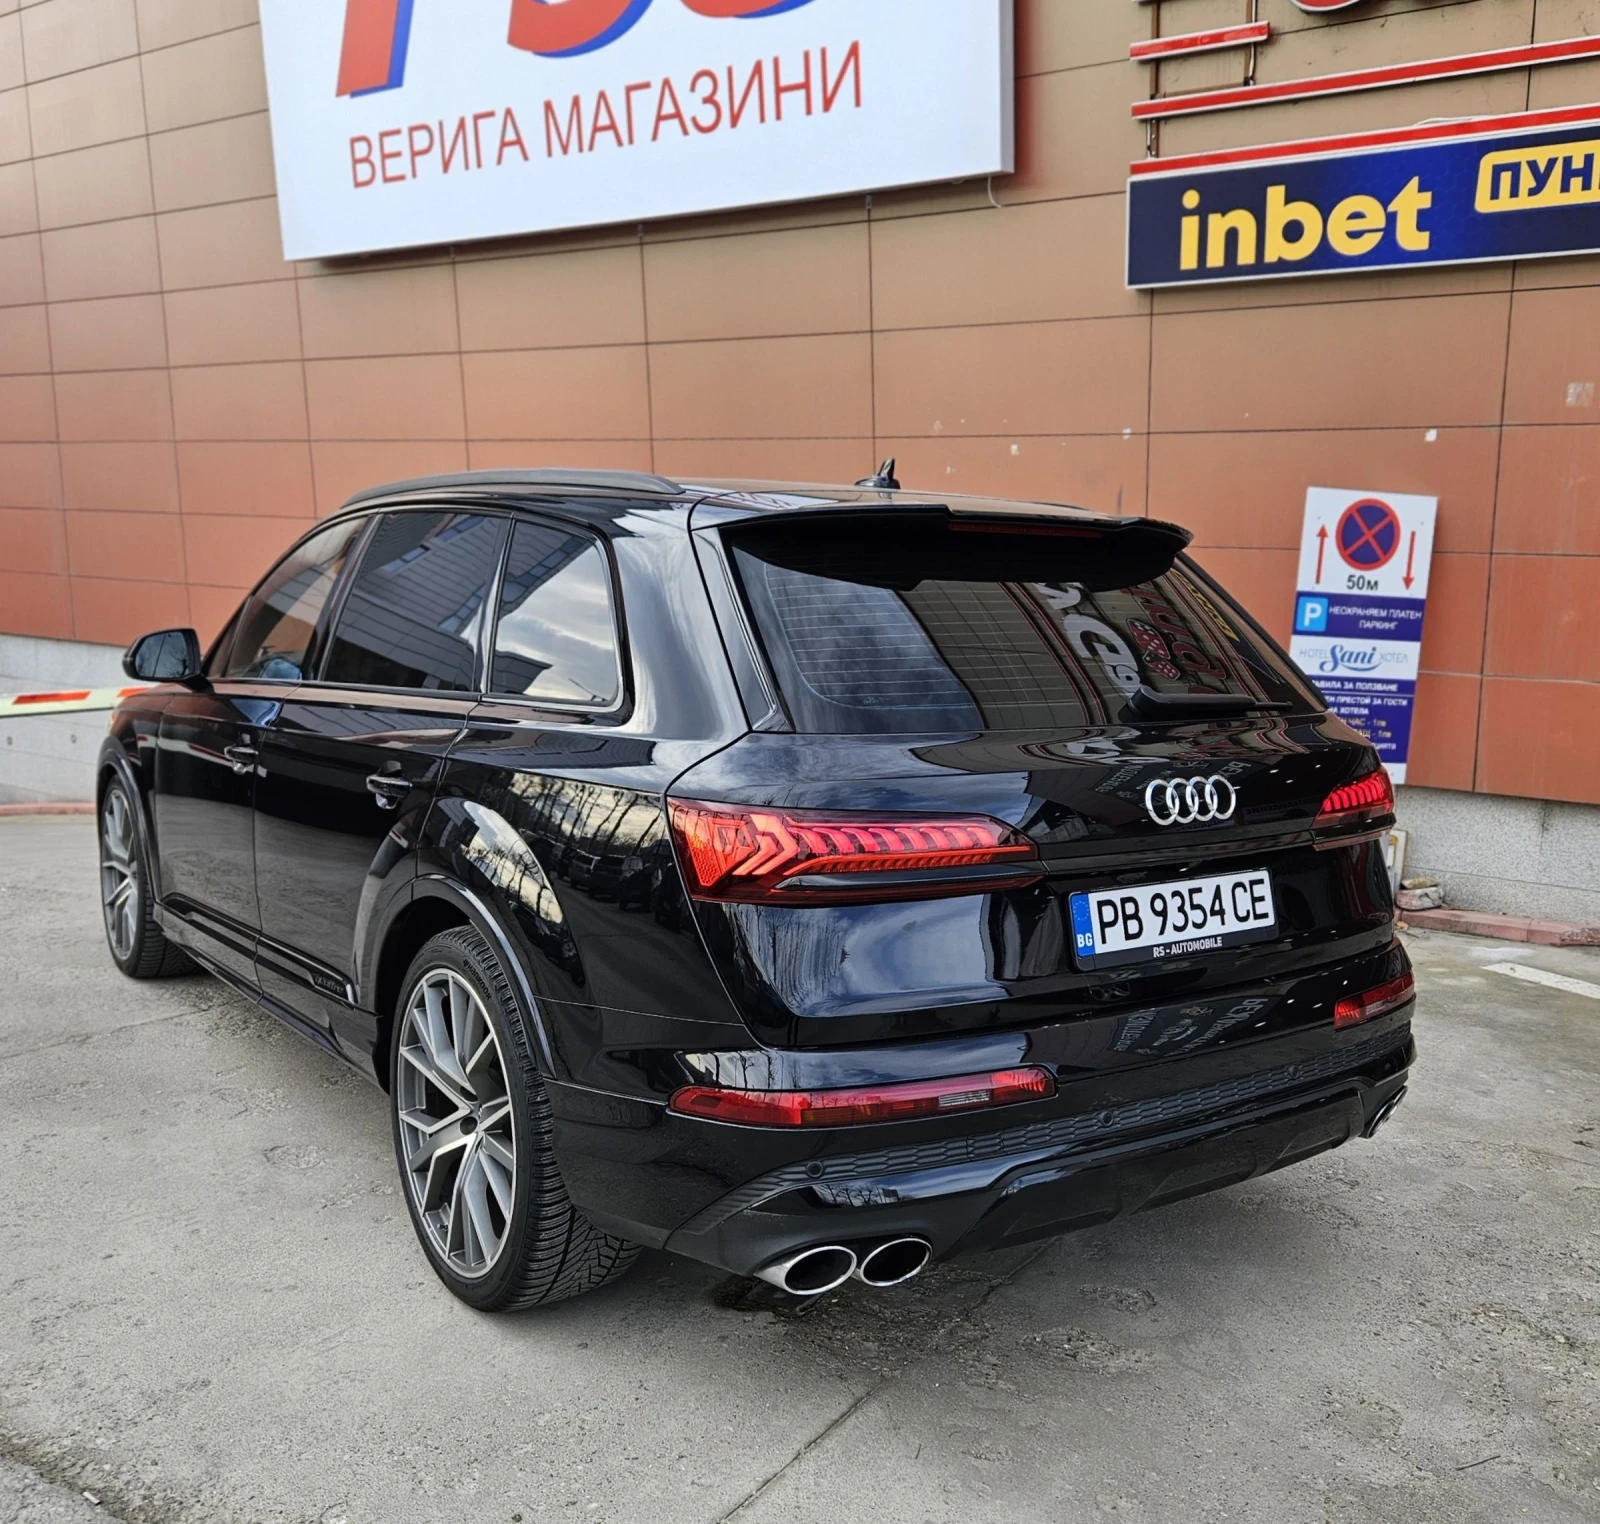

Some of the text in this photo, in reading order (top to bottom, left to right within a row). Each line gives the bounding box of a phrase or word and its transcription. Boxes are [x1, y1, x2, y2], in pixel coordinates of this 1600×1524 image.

[349, 40, 862, 189] ВЕРИГА МАГАЗИНИ
[1489, 152, 1600, 201] ПУН
[1179, 176, 1433, 271] inbet
[1328, 605, 1422, 620] НЕОХРАНЯЕМ ПЛАТЕН
[1358, 619, 1399, 630] ПАРКИНГ
[1299, 647, 1329, 659] HOTEL
[1319, 644, 1378, 673] Sani
[1380, 651, 1409, 664] ХОТЕЛ
[1096, 878, 1270, 945] PB 9354 CE
[1076, 932, 1094, 948] BG
[1153, 945, 1165, 958] RS
[1170, 936, 1223, 955] AUTOMOBILE
